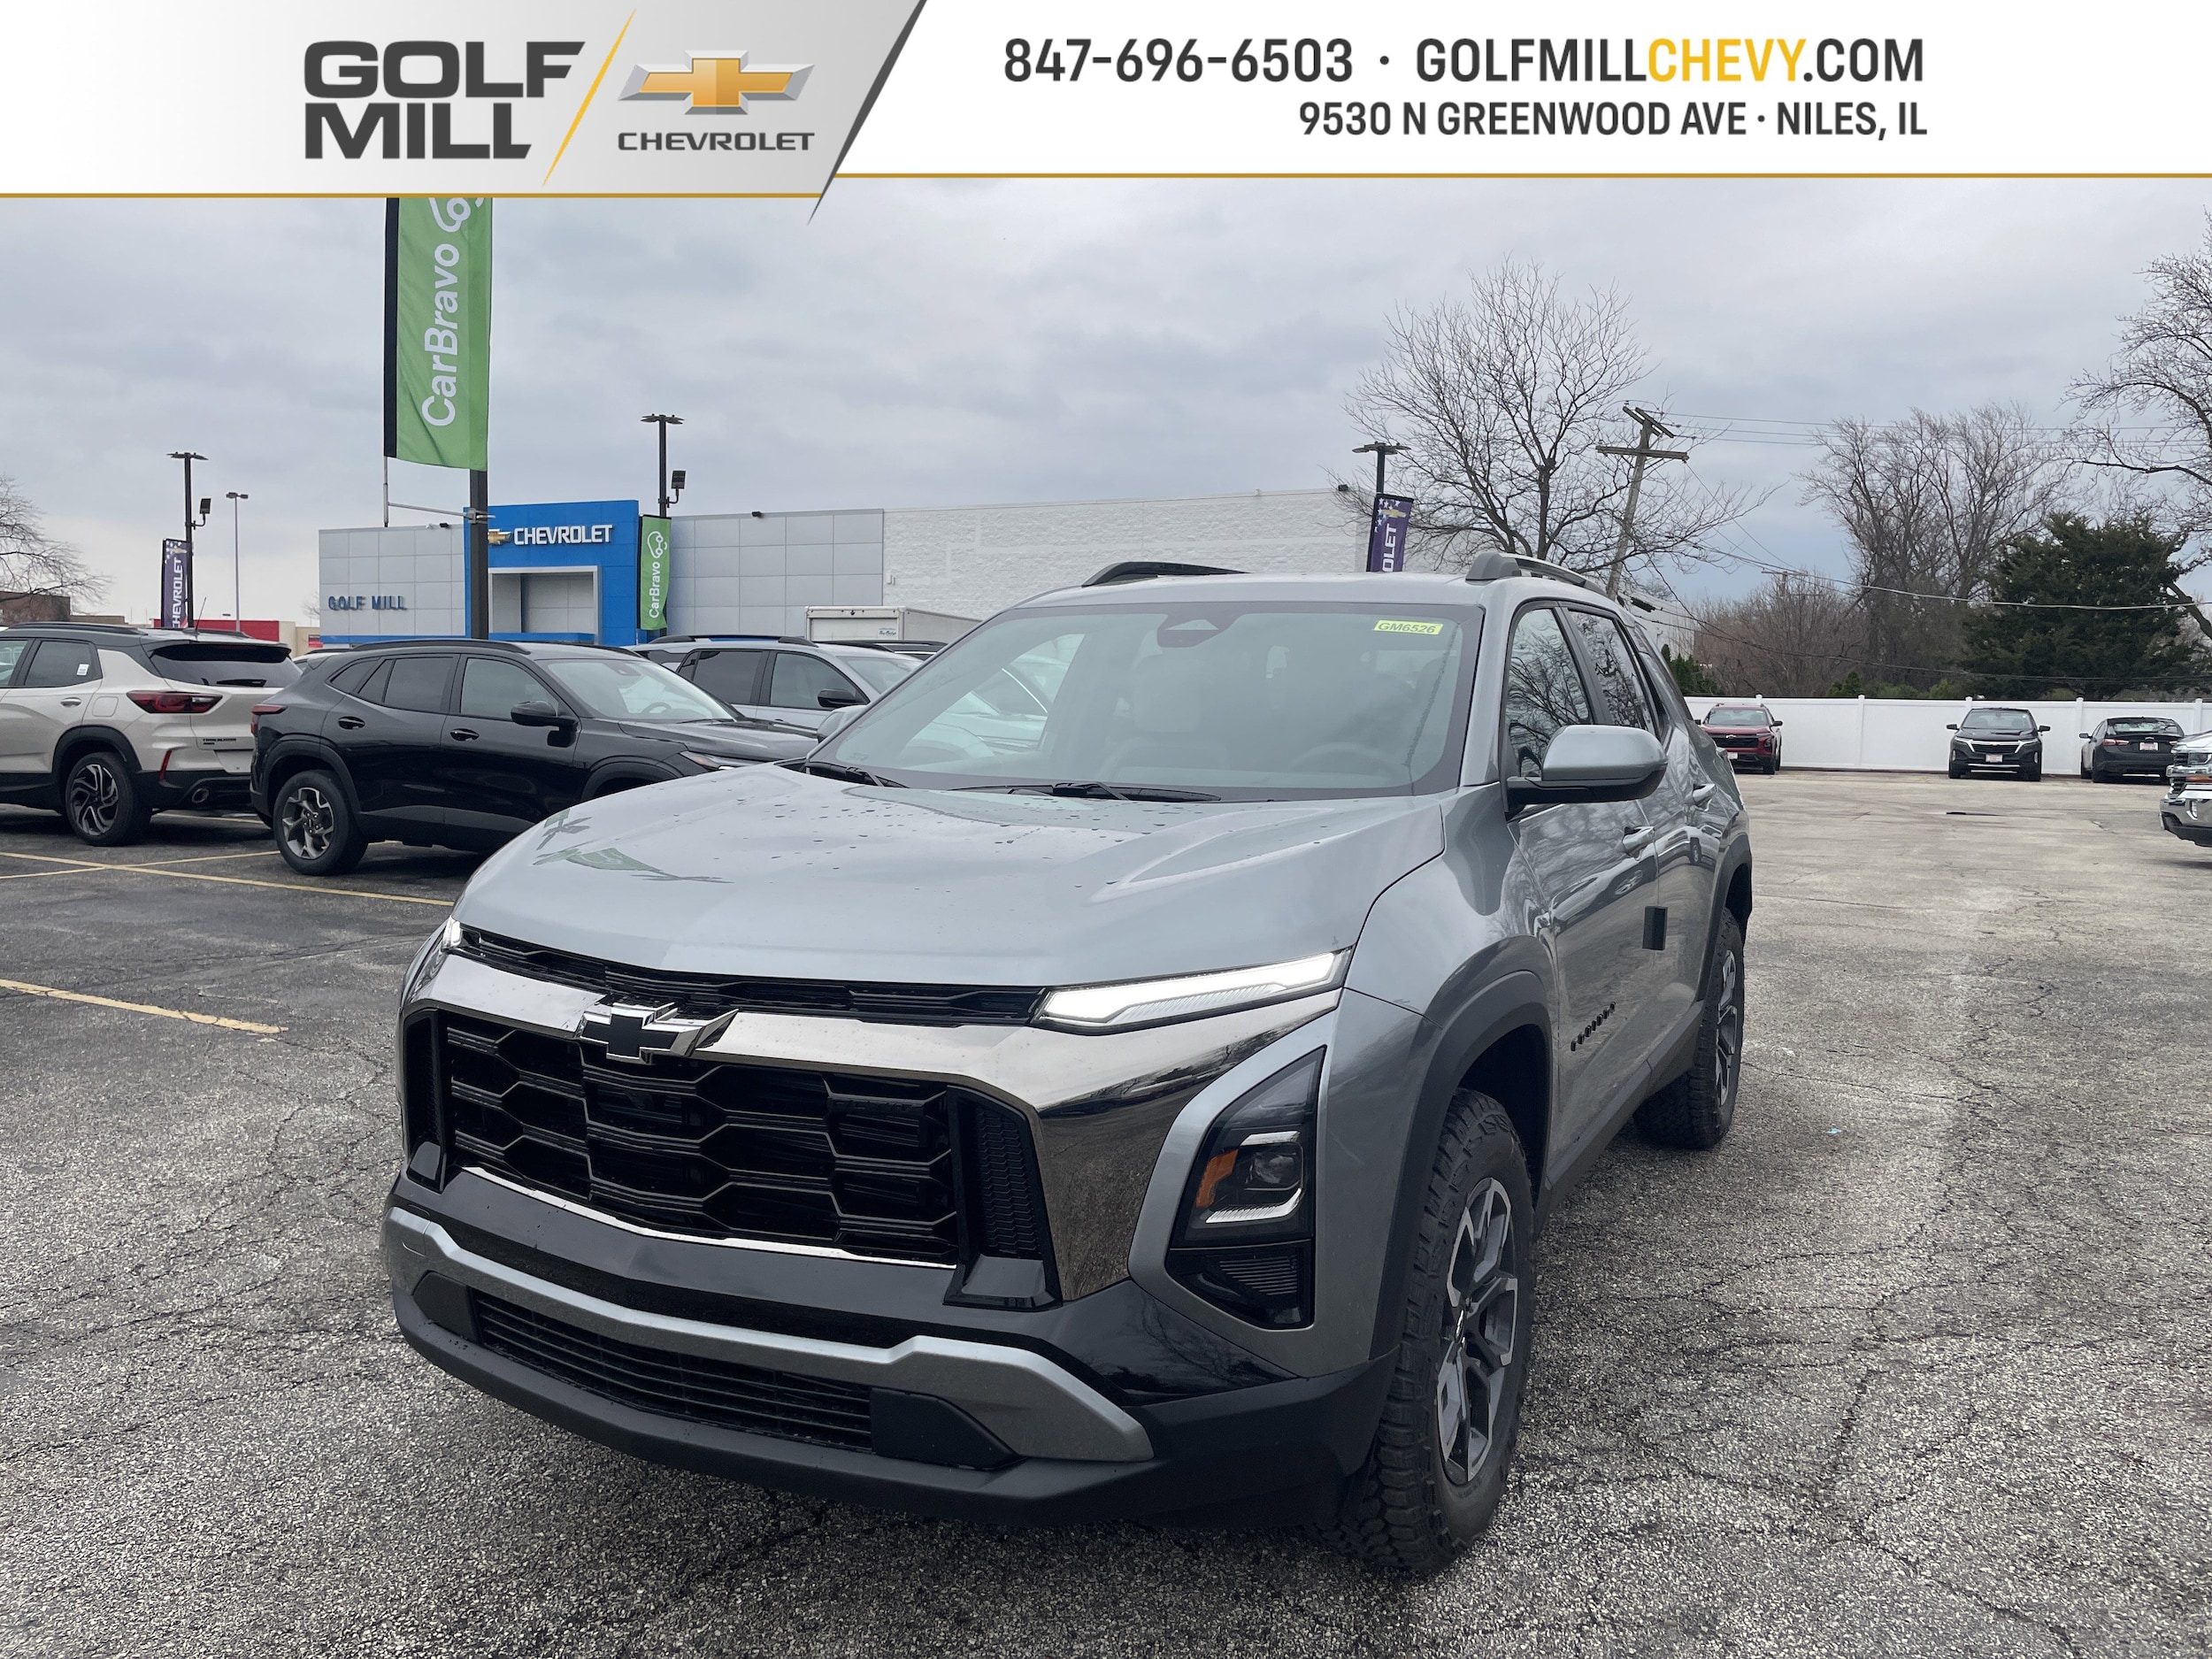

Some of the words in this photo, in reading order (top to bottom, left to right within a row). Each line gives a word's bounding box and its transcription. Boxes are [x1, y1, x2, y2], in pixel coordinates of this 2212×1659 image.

[421, 242, 460, 427] CarBravo
[513, 524, 613, 546] CHEVROLET
[649, 561, 661, 618] CarBravo
[328, 595, 365, 611] GOLF
[372, 595, 407, 611] MILL
[1378, 622, 1437, 634] GM6526
